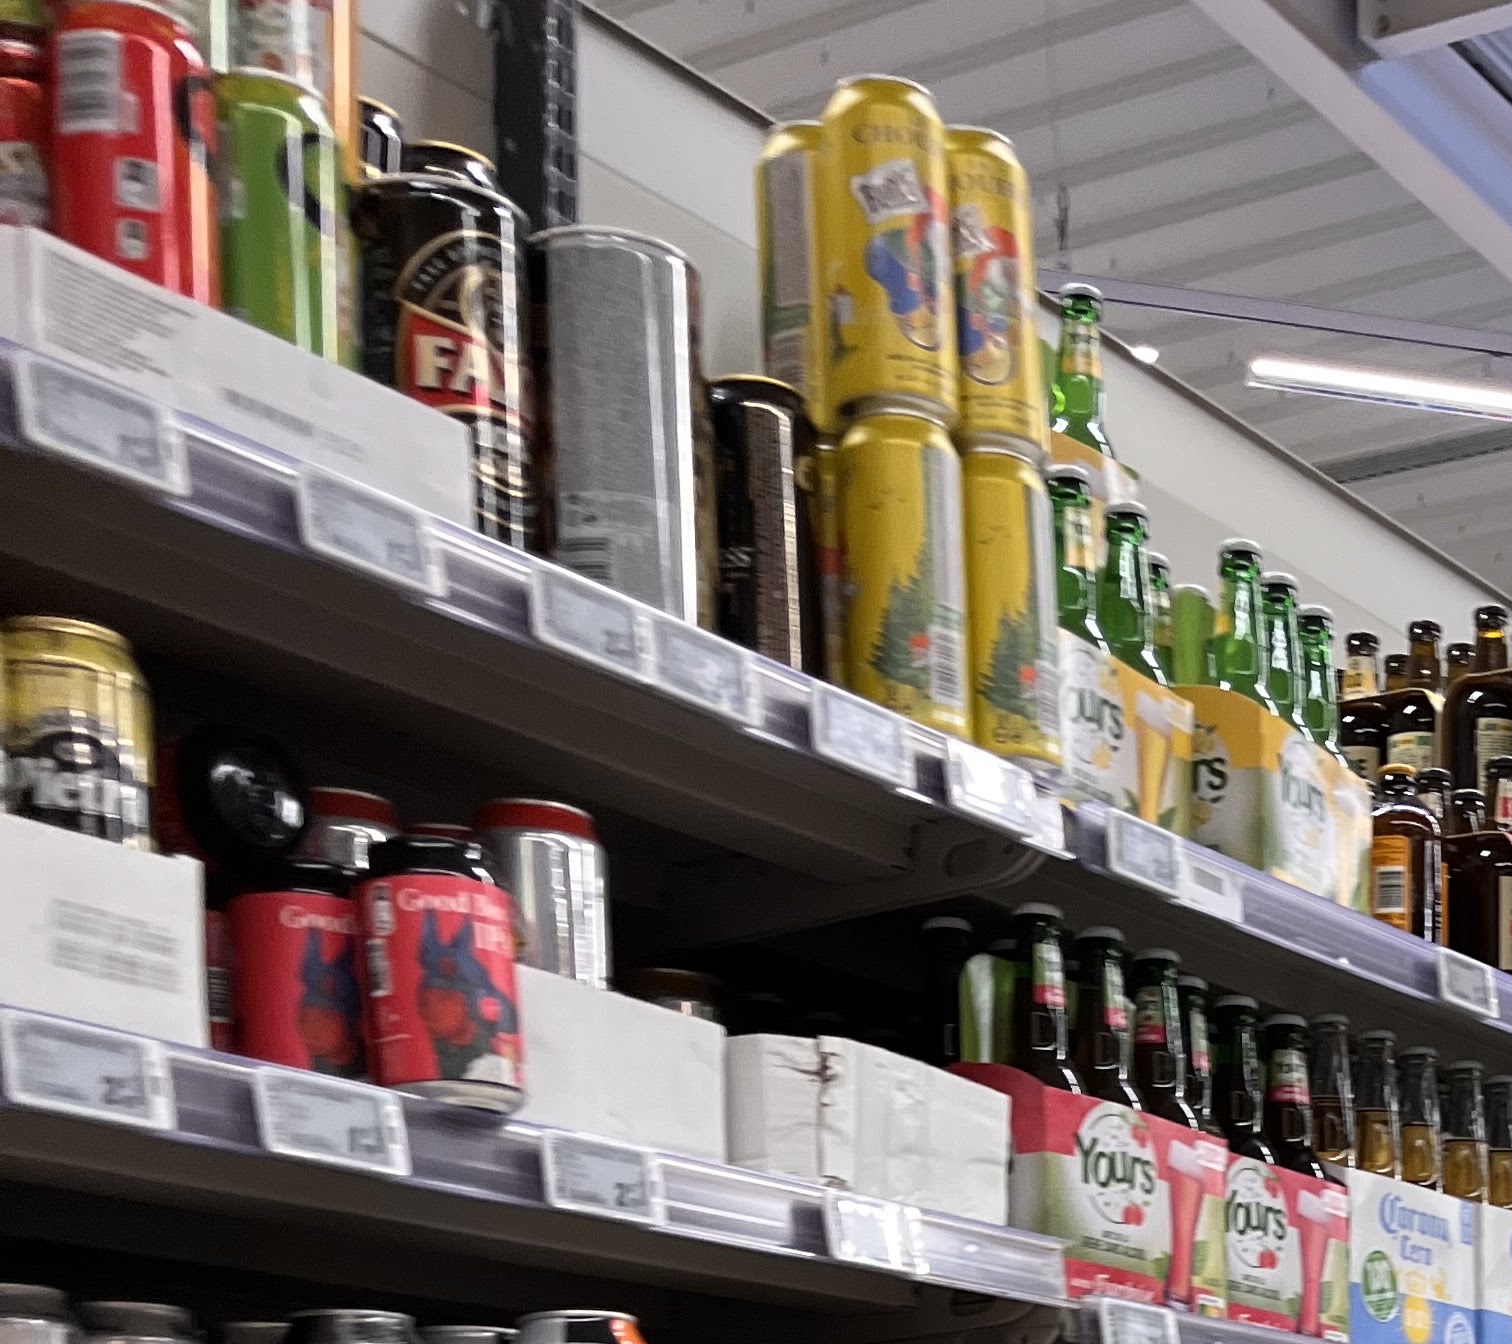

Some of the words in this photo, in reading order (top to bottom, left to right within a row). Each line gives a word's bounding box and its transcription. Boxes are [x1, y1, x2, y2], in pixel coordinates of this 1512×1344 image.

[1074, 1132, 1155, 1194] Yours
[1226, 1190, 1287, 1240] Yours
[1379, 1192, 1449, 1242] Corona
